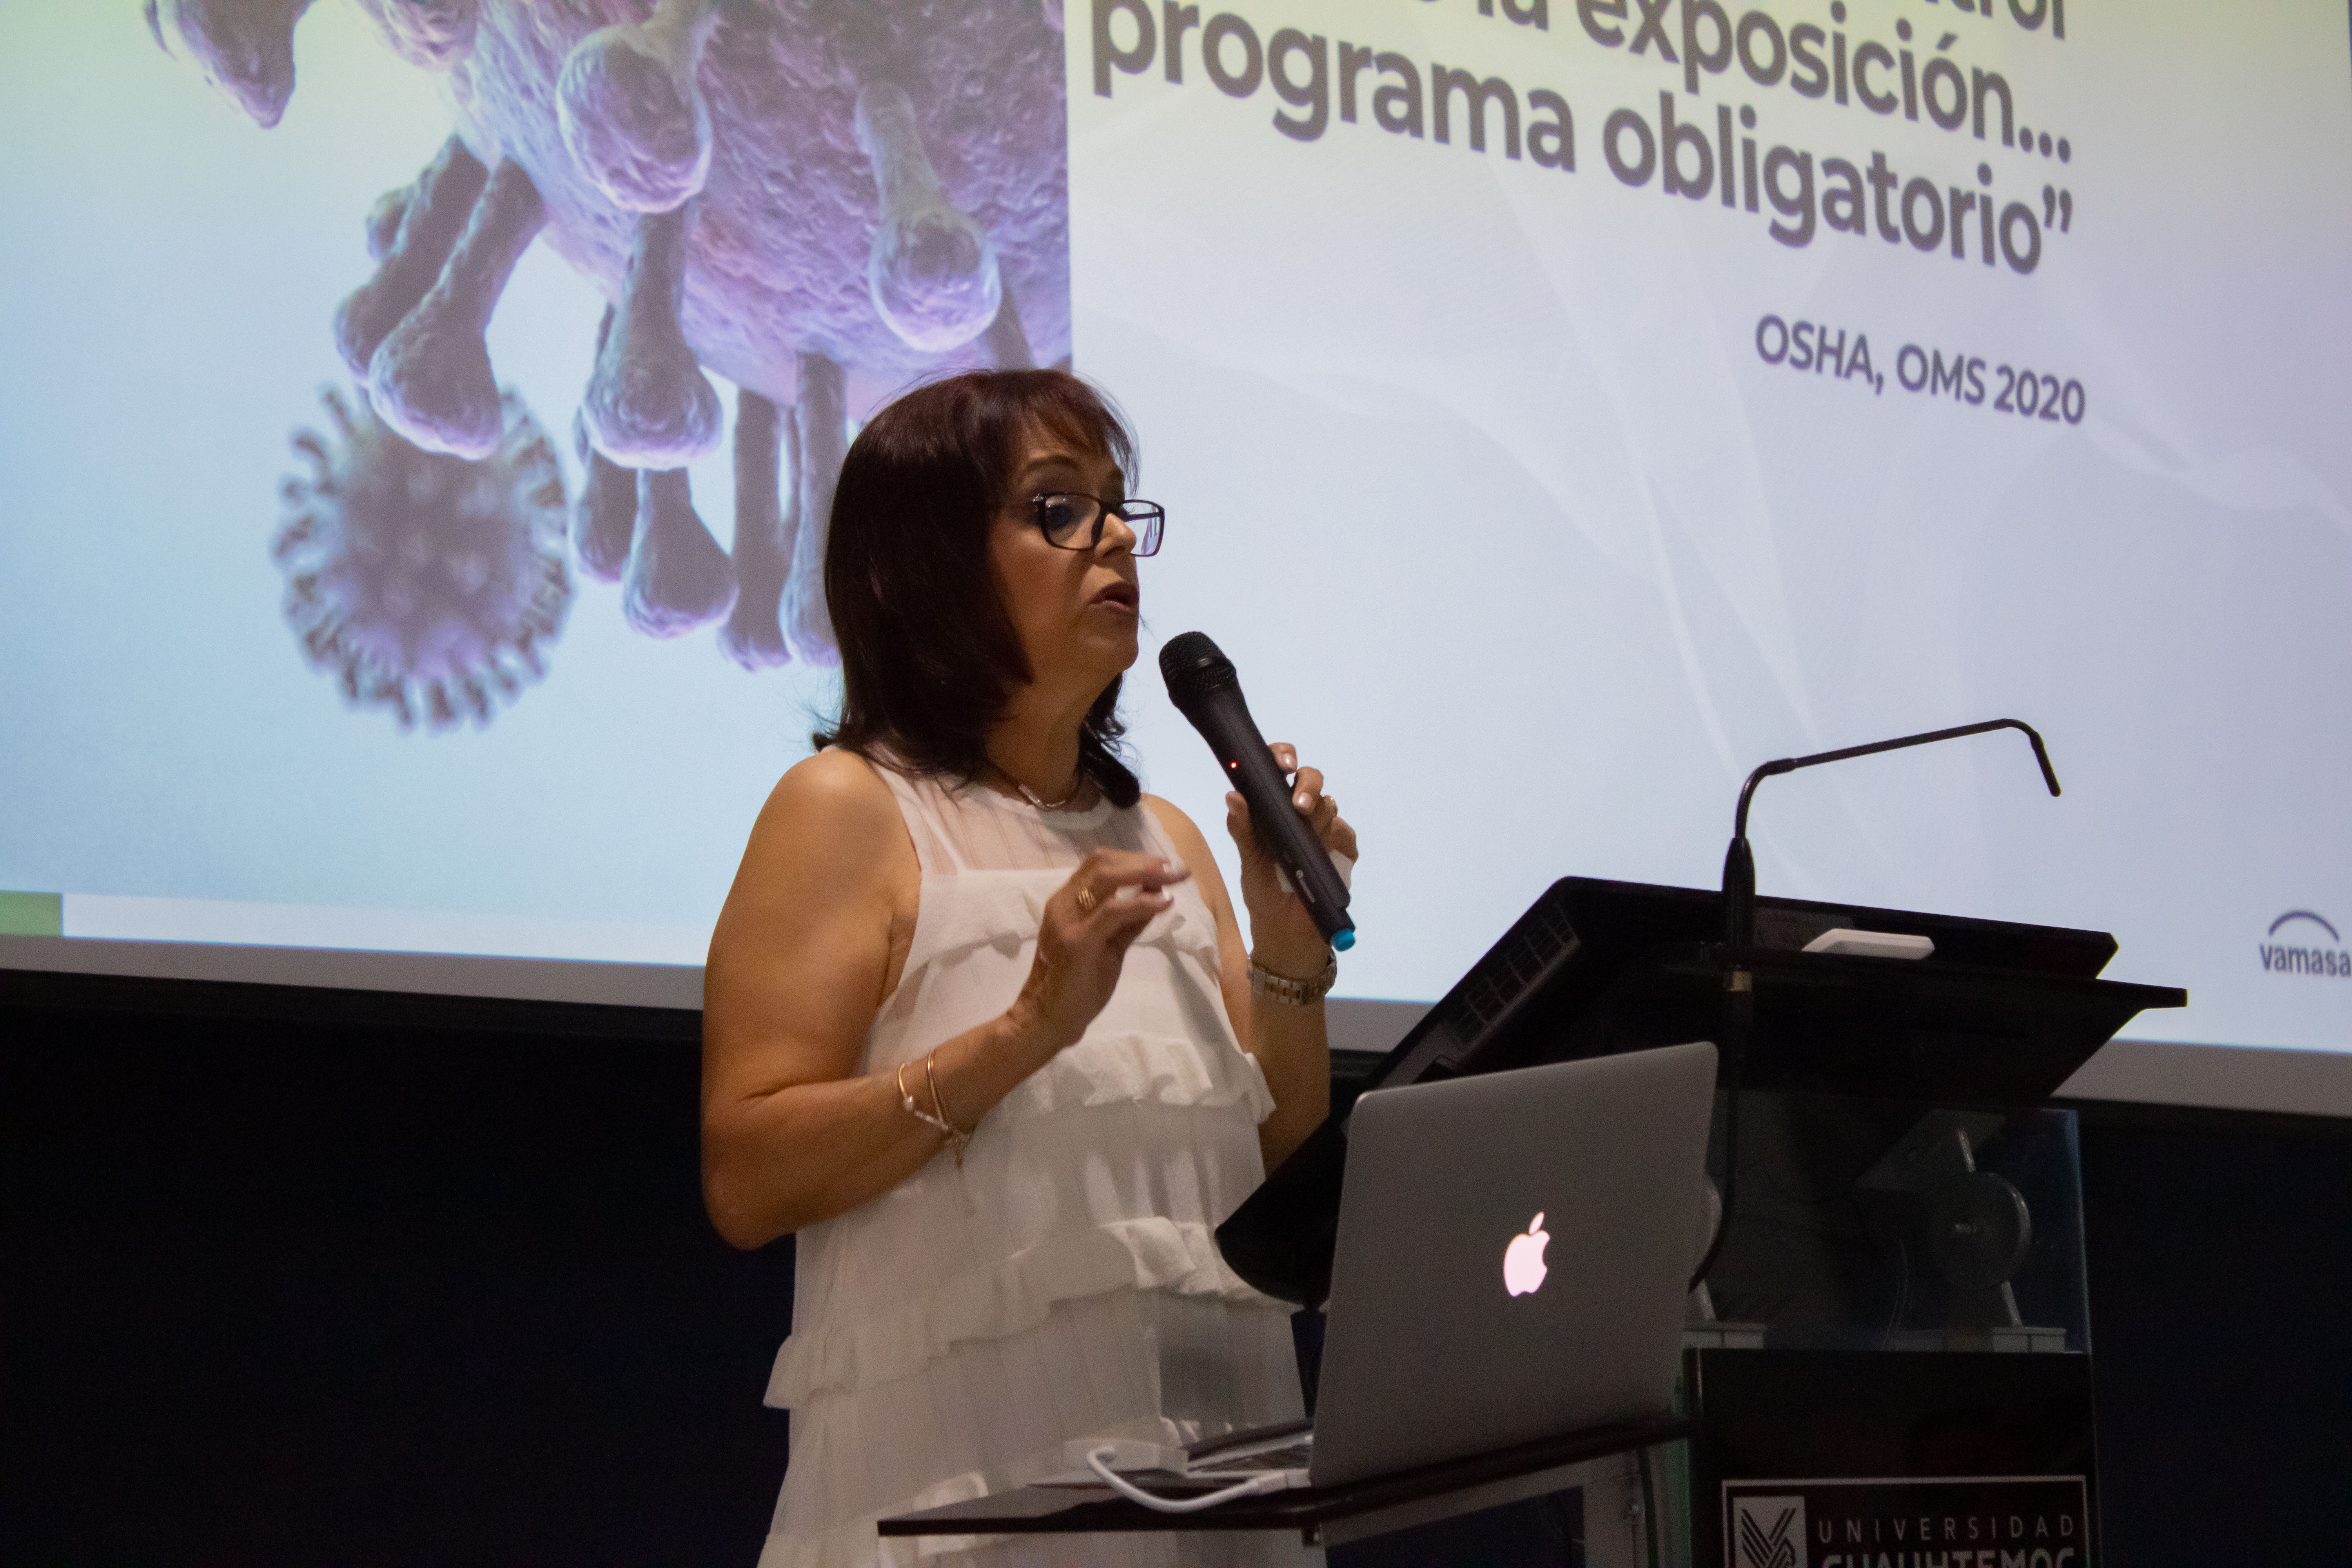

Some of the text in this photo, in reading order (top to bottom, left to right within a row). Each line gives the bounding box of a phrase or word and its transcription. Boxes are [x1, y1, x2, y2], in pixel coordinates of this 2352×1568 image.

[1091, 0, 1575, 172] programa
[1755, 314, 2086, 425] OSHA, OMS 2020
[2259, 944, 2352, 978] vamasa
[1818, 1514, 2074, 1543] UNIVERSIDAD
